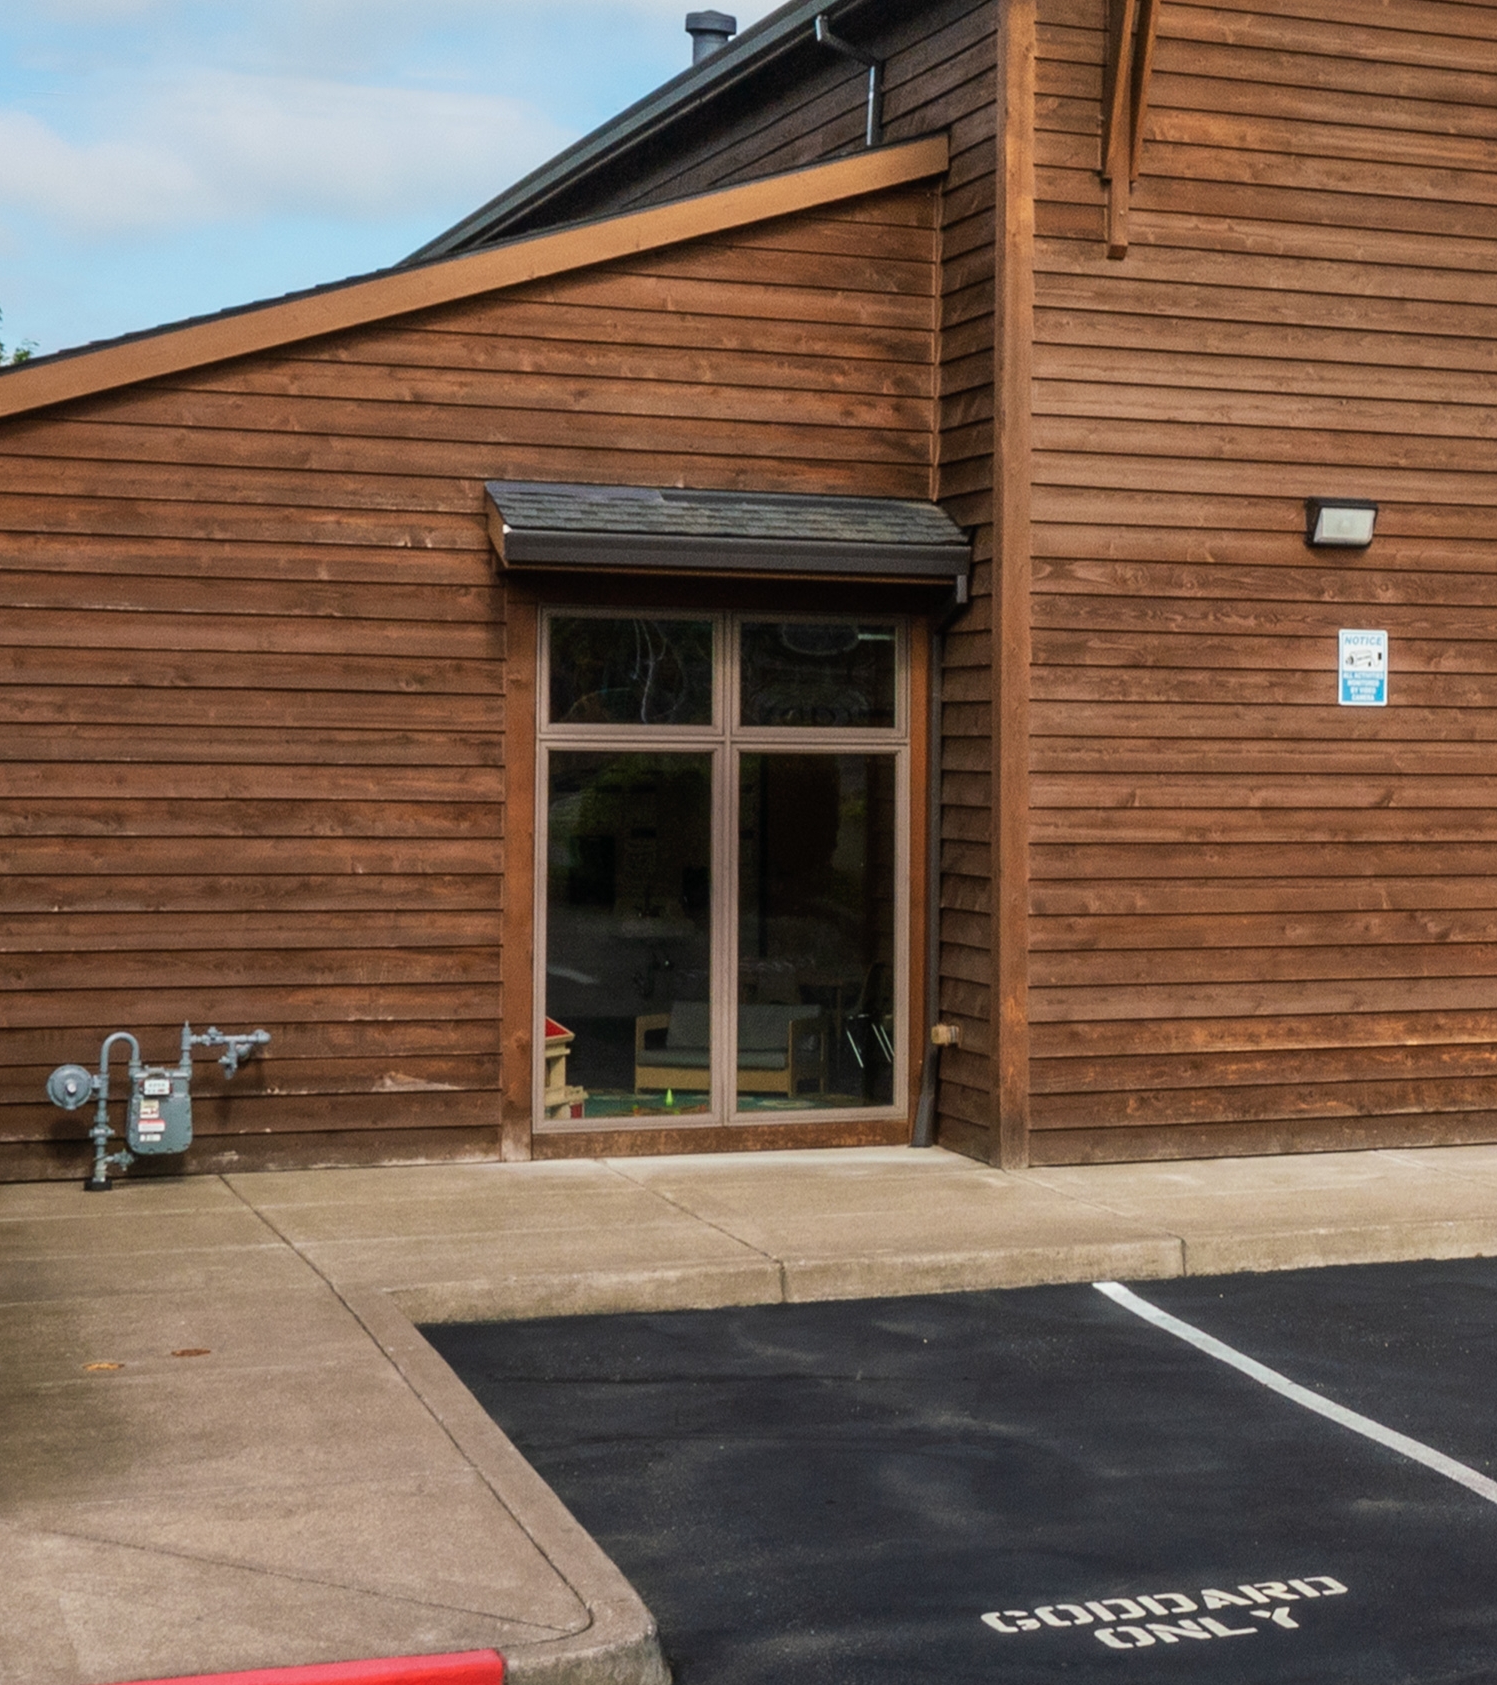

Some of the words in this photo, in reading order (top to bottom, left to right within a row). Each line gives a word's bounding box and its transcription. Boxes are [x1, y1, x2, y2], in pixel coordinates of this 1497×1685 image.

[1345, 636, 1382, 646] NOTICE
[980, 1576, 1349, 1633] GODDARD
[1094, 1606, 1300, 1649] ONLY
